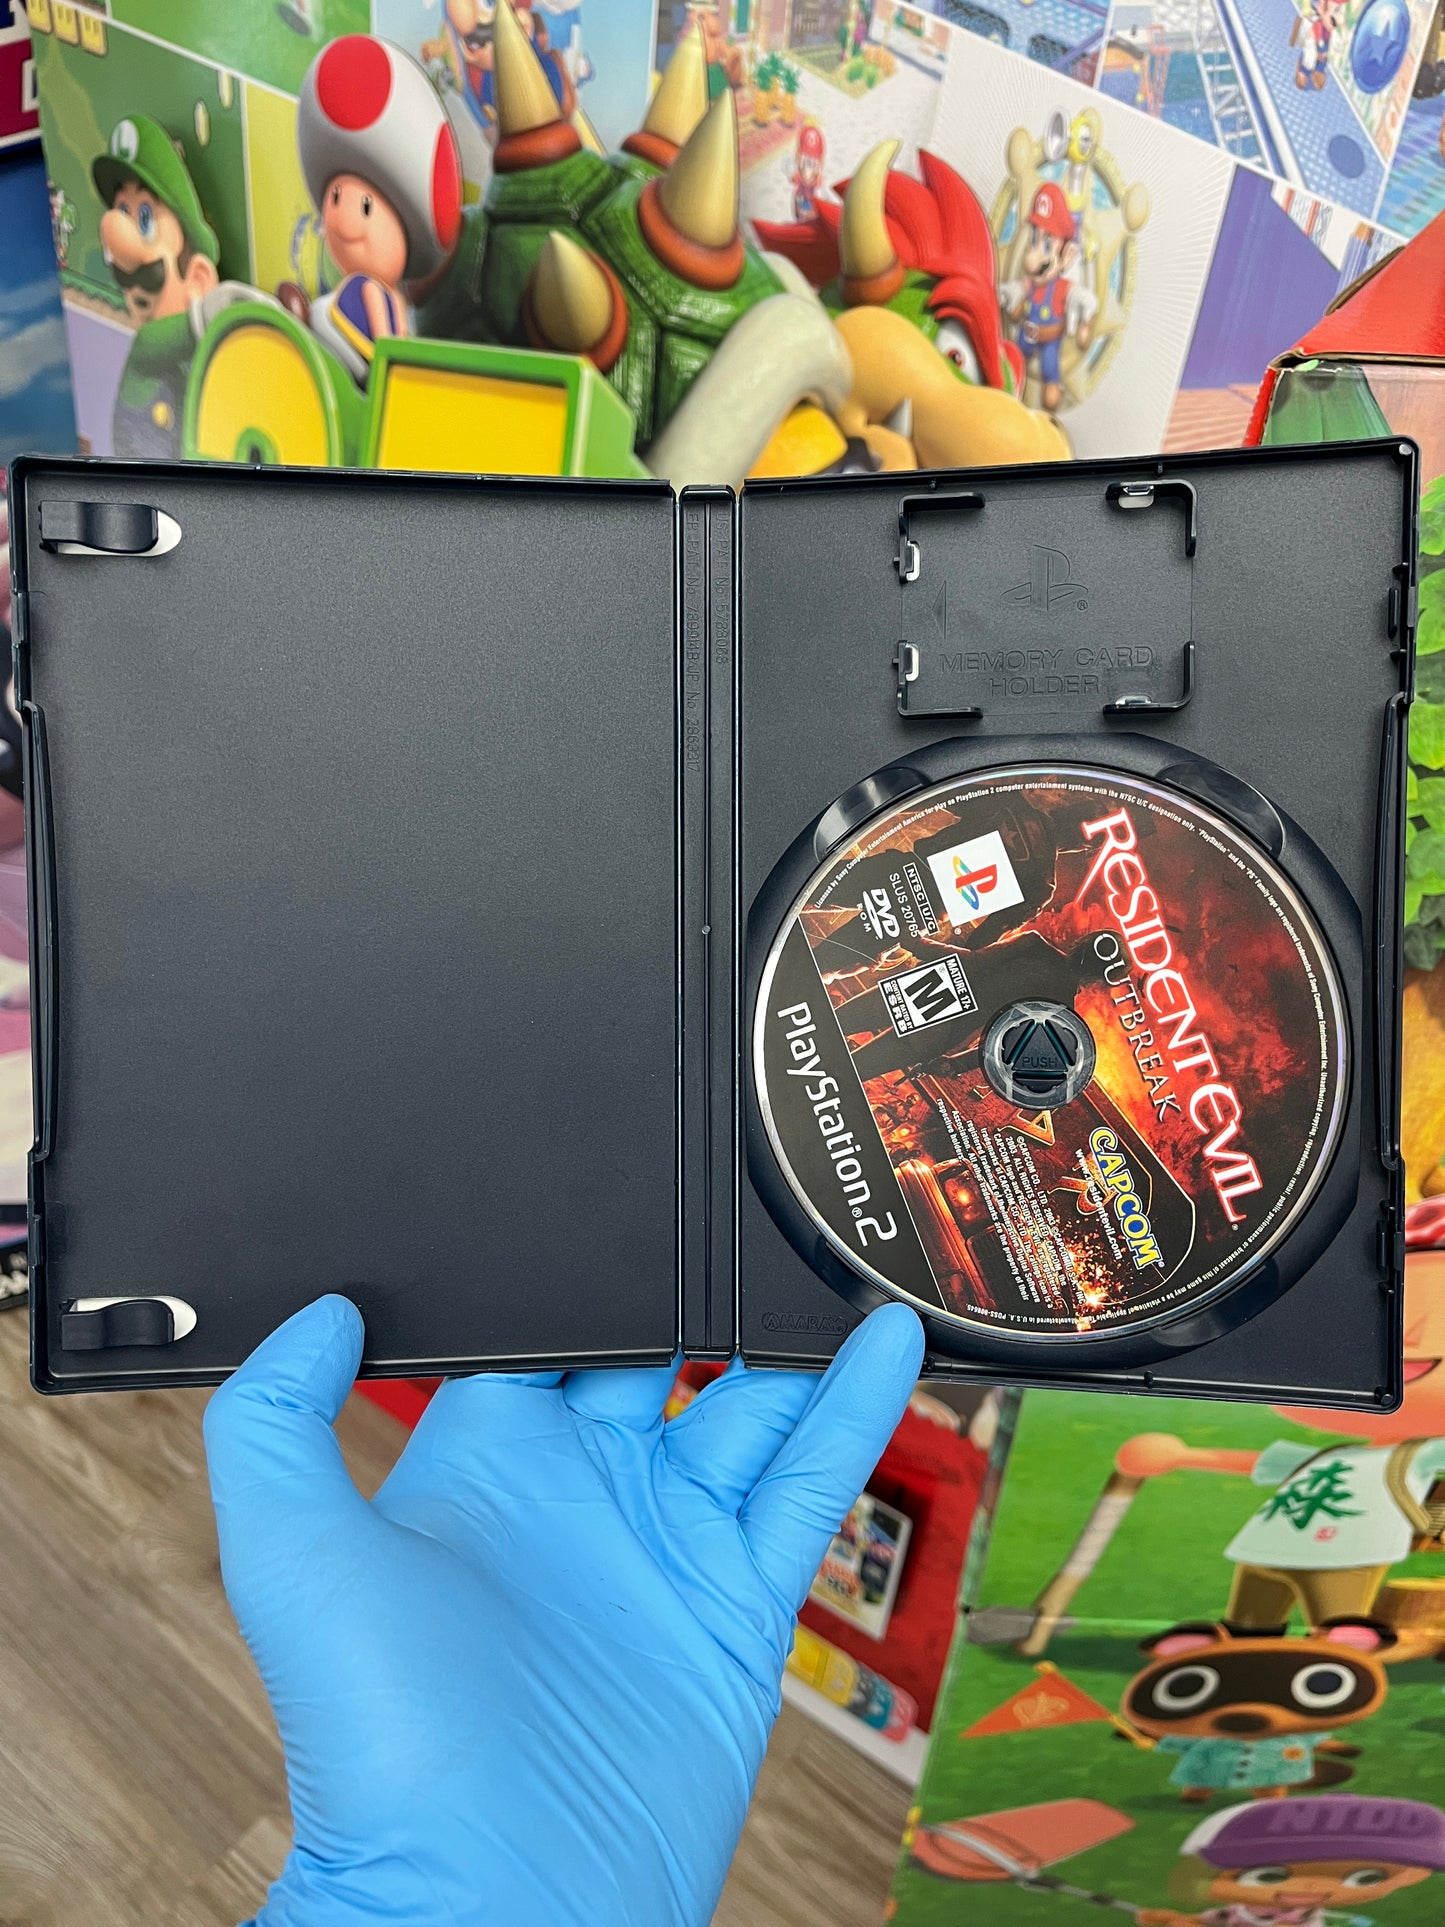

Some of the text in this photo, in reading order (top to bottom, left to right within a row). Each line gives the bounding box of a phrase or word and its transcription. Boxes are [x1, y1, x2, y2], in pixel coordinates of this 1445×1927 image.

[686, 577, 699, 593] No
[715, 576, 728, 593] No
[939, 646, 1153, 672] MEMORY CARD
[989, 674, 1099, 697] HOLDER
[956, 789, 989, 802] PlayStation
[996, 784, 1023, 793] computer
[1069, 784, 1092, 792] systems
[1094, 786, 1107, 794] with
[1109, 789, 1118, 797] the
[1119, 793, 1136, 802] NTSC
[924, 806, 934, 814] for
[933, 802, 946, 811] play
[1135, 798, 1148, 807] U/C
[1146, 802, 1182, 822] designation
[902, 810, 925, 826] America
[867, 822, 903, 850] Entertainment
[845, 847, 870, 870] Computer
[1228, 851, 1239, 863] and
[1236, 859, 1245, 869] the
[835, 867, 849, 881] Sony
[813, 885, 833, 908] Licensed
[906, 867, 936, 930] NTSC U/C
[1255, 879, 1271, 898] Family
[888, 871, 921, 937] SLUS 20765
[1265, 894, 1279, 908] logo
[1274, 906, 1284, 916] are
[870, 888, 900, 938] DVD
[1279, 914, 1300, 943] registered
[1294, 940, 1311, 972] trademarks
[945, 957, 973, 1010] MATURE 17+
[1309, 978, 1318, 992] Sony
[890, 979, 913, 1029] CONTENT RATED BY
[904, 969, 956, 1021] M
[881, 981, 908, 1032] ESRB
[1077, 807, 1264, 1224] RESIDENT EVIL
[1313, 993, 1324, 1019] Computer
[1092, 931, 1182, 1123] OUTBREAK
[1319, 1021, 1327, 1058] Entertainment
[1022, 1056, 1058, 1068] PUSH
[1315, 1072, 1327, 1111] Unauthorized
[776, 1001, 898, 1247] PlayStation 2
[935, 1097, 955, 1133] respective
[950, 1109, 972, 1151] Association.
[979, 1127, 1000, 1166] trademarks
[1005, 1136, 1018, 1156] 2003.
[967, 1151, 977, 1163] All
[1013, 1157, 1024, 1171] ALL
[971, 1163, 984, 1181] other
[997, 1174, 1015, 1205] CAPCOM
[1018, 1171, 1034, 1199] RIGHTS
[980, 1181, 999, 1221] trademarks
[1036, 1190, 1048, 1207] LTD.
[1043, 1208, 1055, 1225] 2003
[1074, 1147, 1125, 1260] www.residentevil.com
[1088, 1127, 1163, 1269] CAPCOM
[1270, 1196, 1286, 1213] public
[964, 1119, 984, 1155] registered
[979, 1154, 998, 1190] trademark
[995, 1198, 1005, 1210] the
[1000, 1210, 1020, 1247] Interactive
[1013, 1247, 1029, 1272] Digital
[1023, 1272, 1041, 1302] Software
[992, 1133, 1060, 1296] CAPCOM logo and RESIDENT EVIL are registered
[993, 1222, 1002, 1233] are
[1015, 1222, 1027, 1238] LTD.
[1245, 1210, 1276, 1243] performance
[999, 1233, 1008, 1245] the
[1022, 1240, 1033, 1254] The
[1003, 1245, 1019, 1274] property
[1026, 1253, 1042, 1279] ratings
[1217, 1245, 1244, 1269] broadcast
[1057, 1274, 1067, 1286] the
[1185, 1276, 1203, 1289] game
[1201, 1269, 1214, 1281] this
[1018, 1283, 1030, 1300] their
[1038, 1278, 1048, 1294] icon
[1174, 1285, 1186, 1296] may
[766, 1312, 842, 1332] AMARAY
